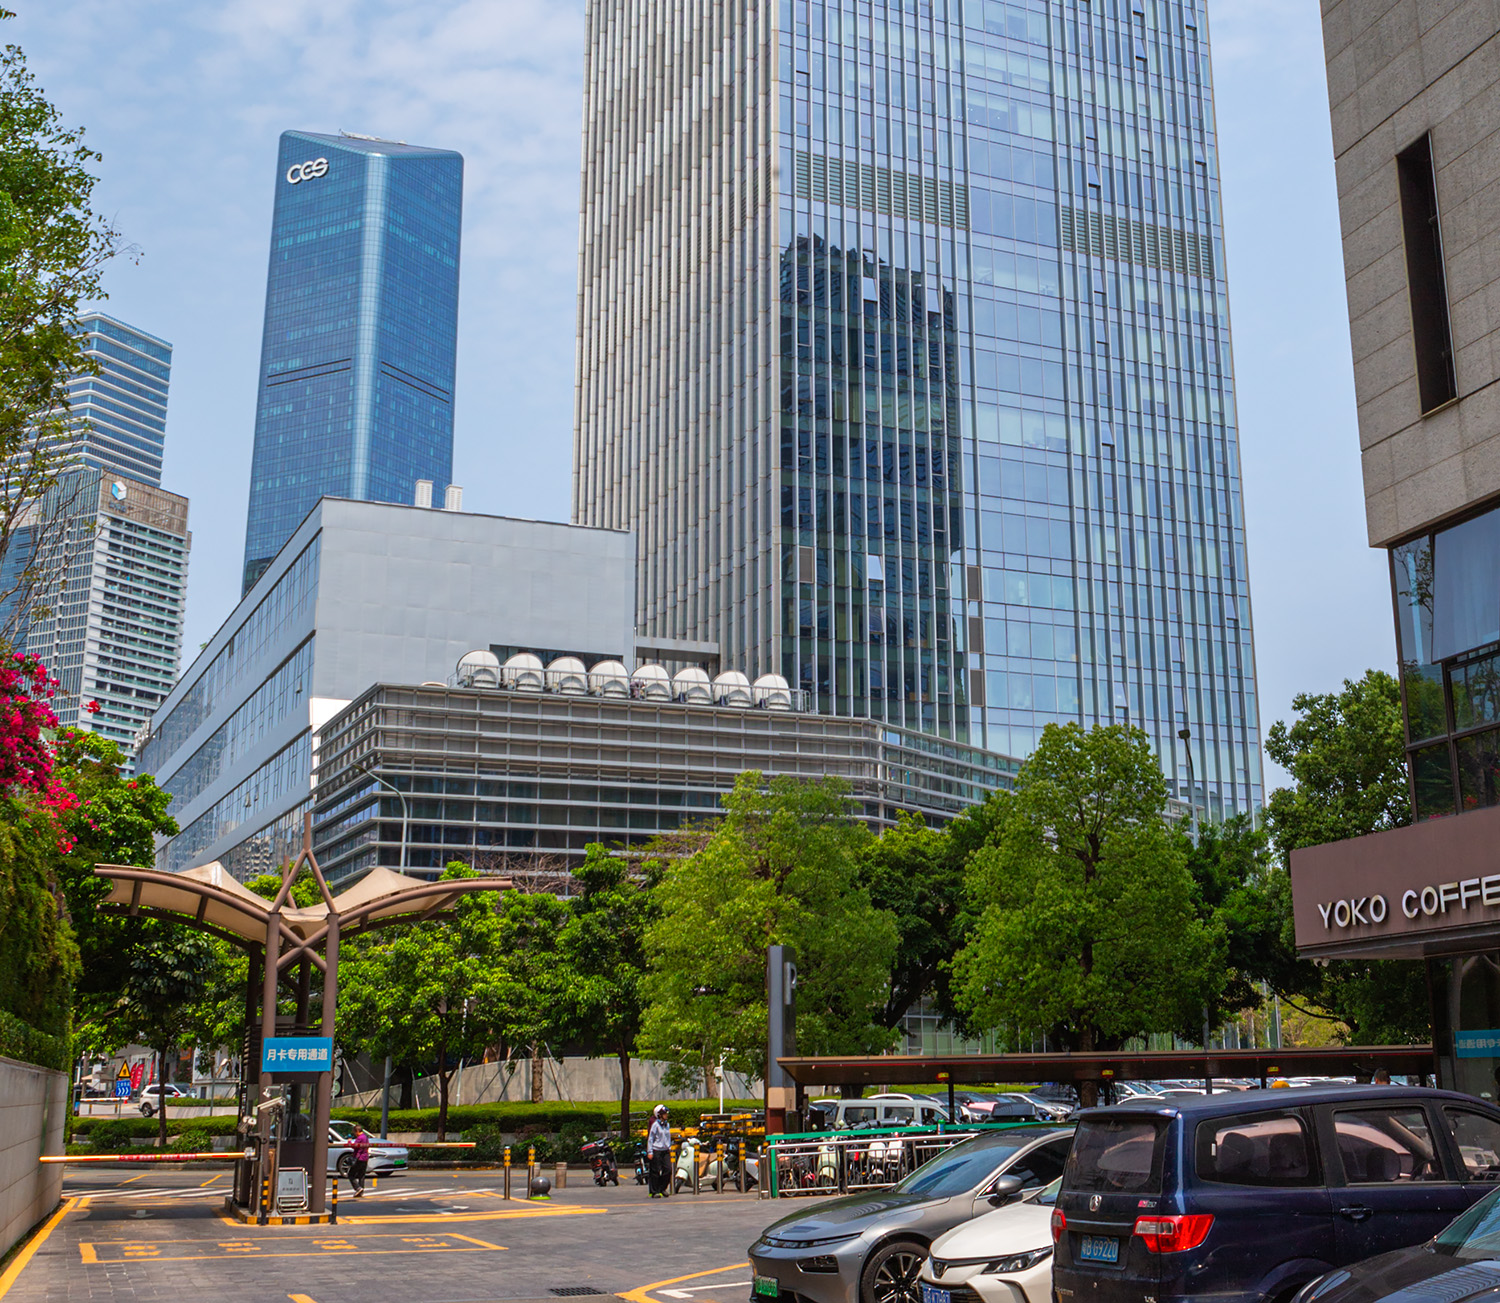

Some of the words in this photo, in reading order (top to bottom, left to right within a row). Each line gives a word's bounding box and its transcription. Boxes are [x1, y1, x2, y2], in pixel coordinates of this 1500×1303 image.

[1317, 894, 1387, 929] YOKO
[1402, 874, 1500, 919] COFFE
[266, 1048, 329, 1061] 月卡专用通道
